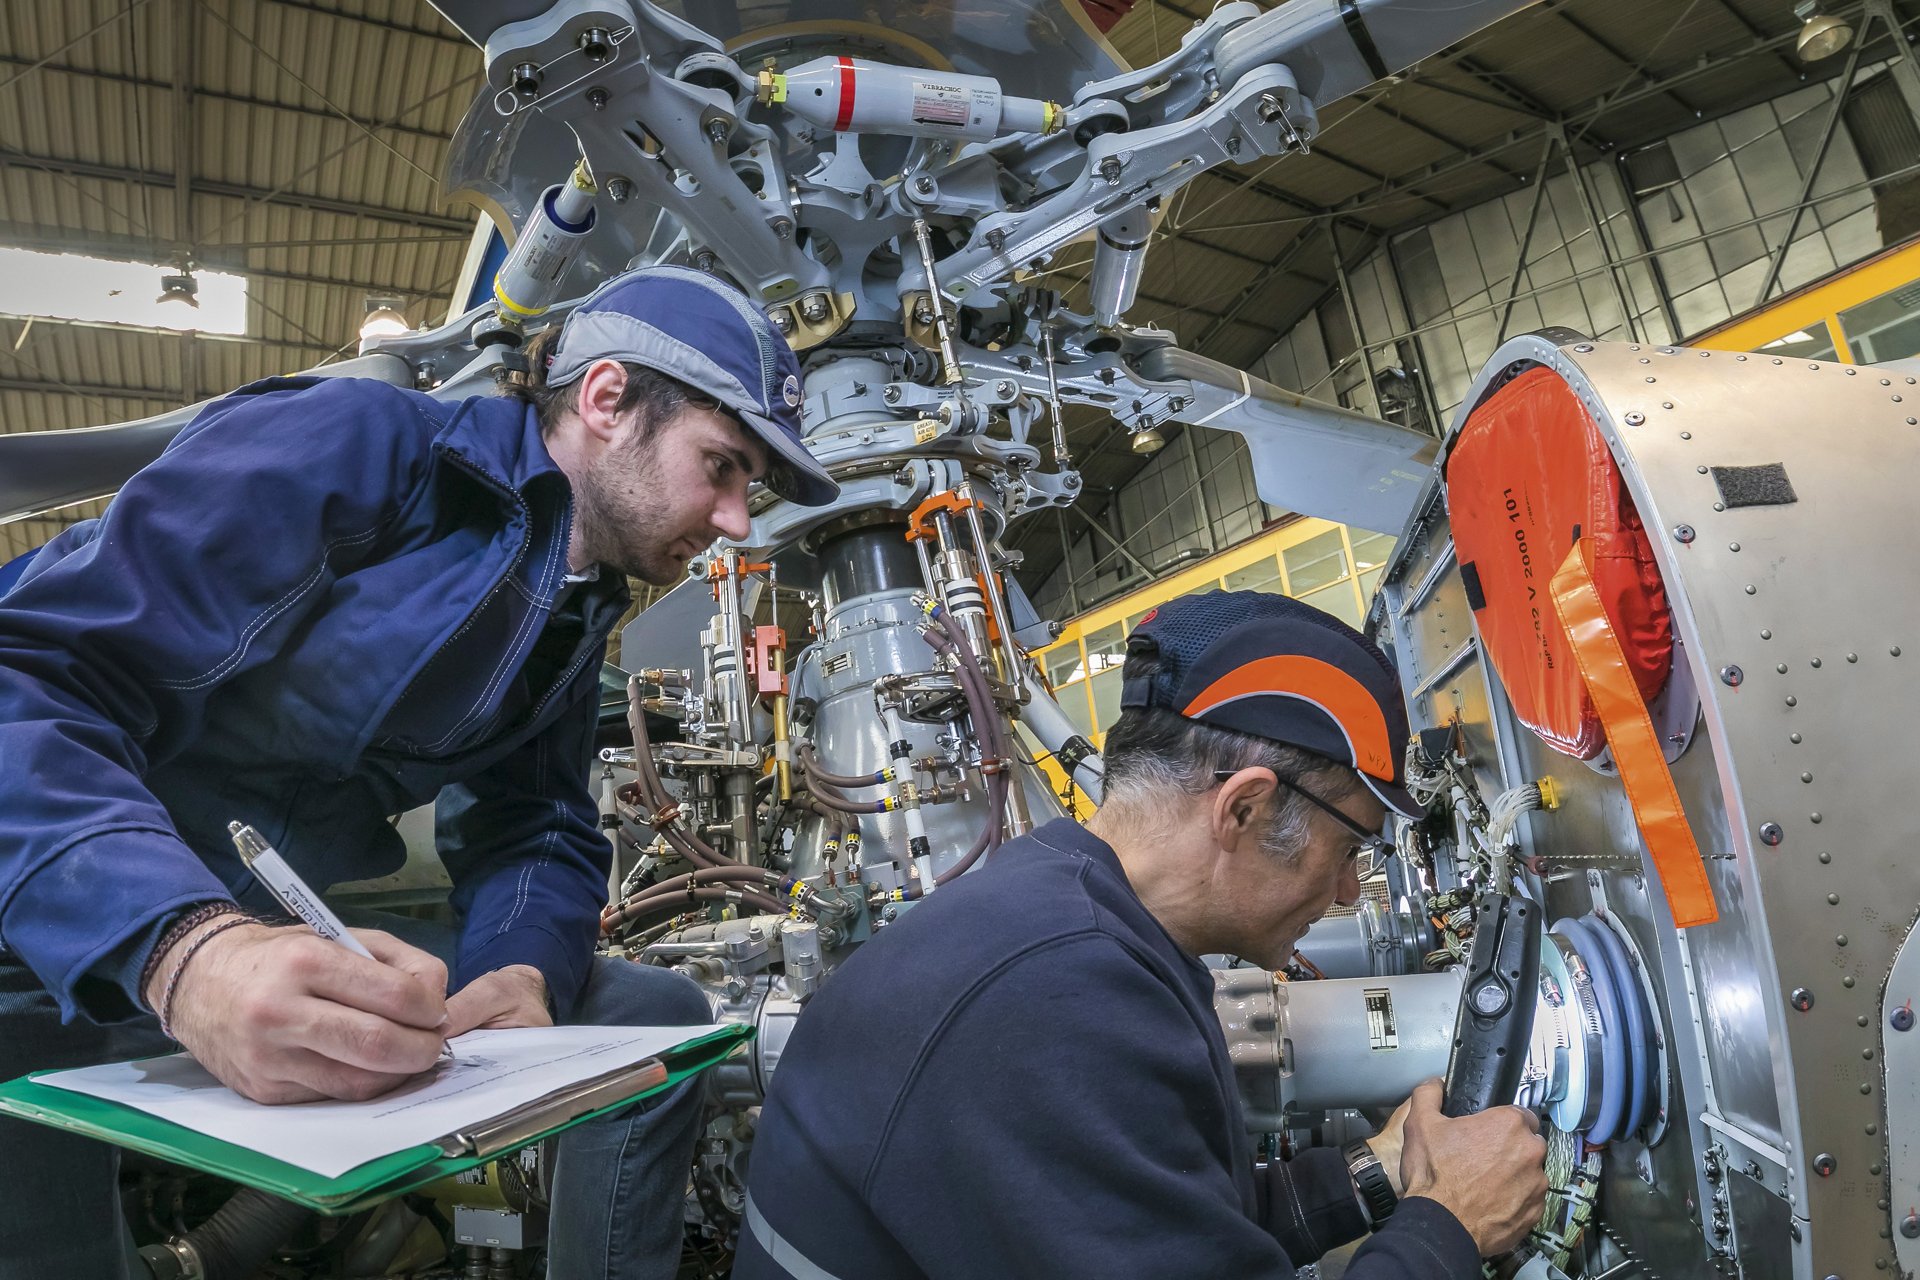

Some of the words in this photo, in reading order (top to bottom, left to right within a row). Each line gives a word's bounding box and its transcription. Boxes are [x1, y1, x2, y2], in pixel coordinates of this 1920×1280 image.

[922, 83, 962, 94] VIBRACHOC
[1503, 488, 1521, 523] 101
[1515, 529, 1533, 579] 2000
[1527, 585, 1537, 601] V
